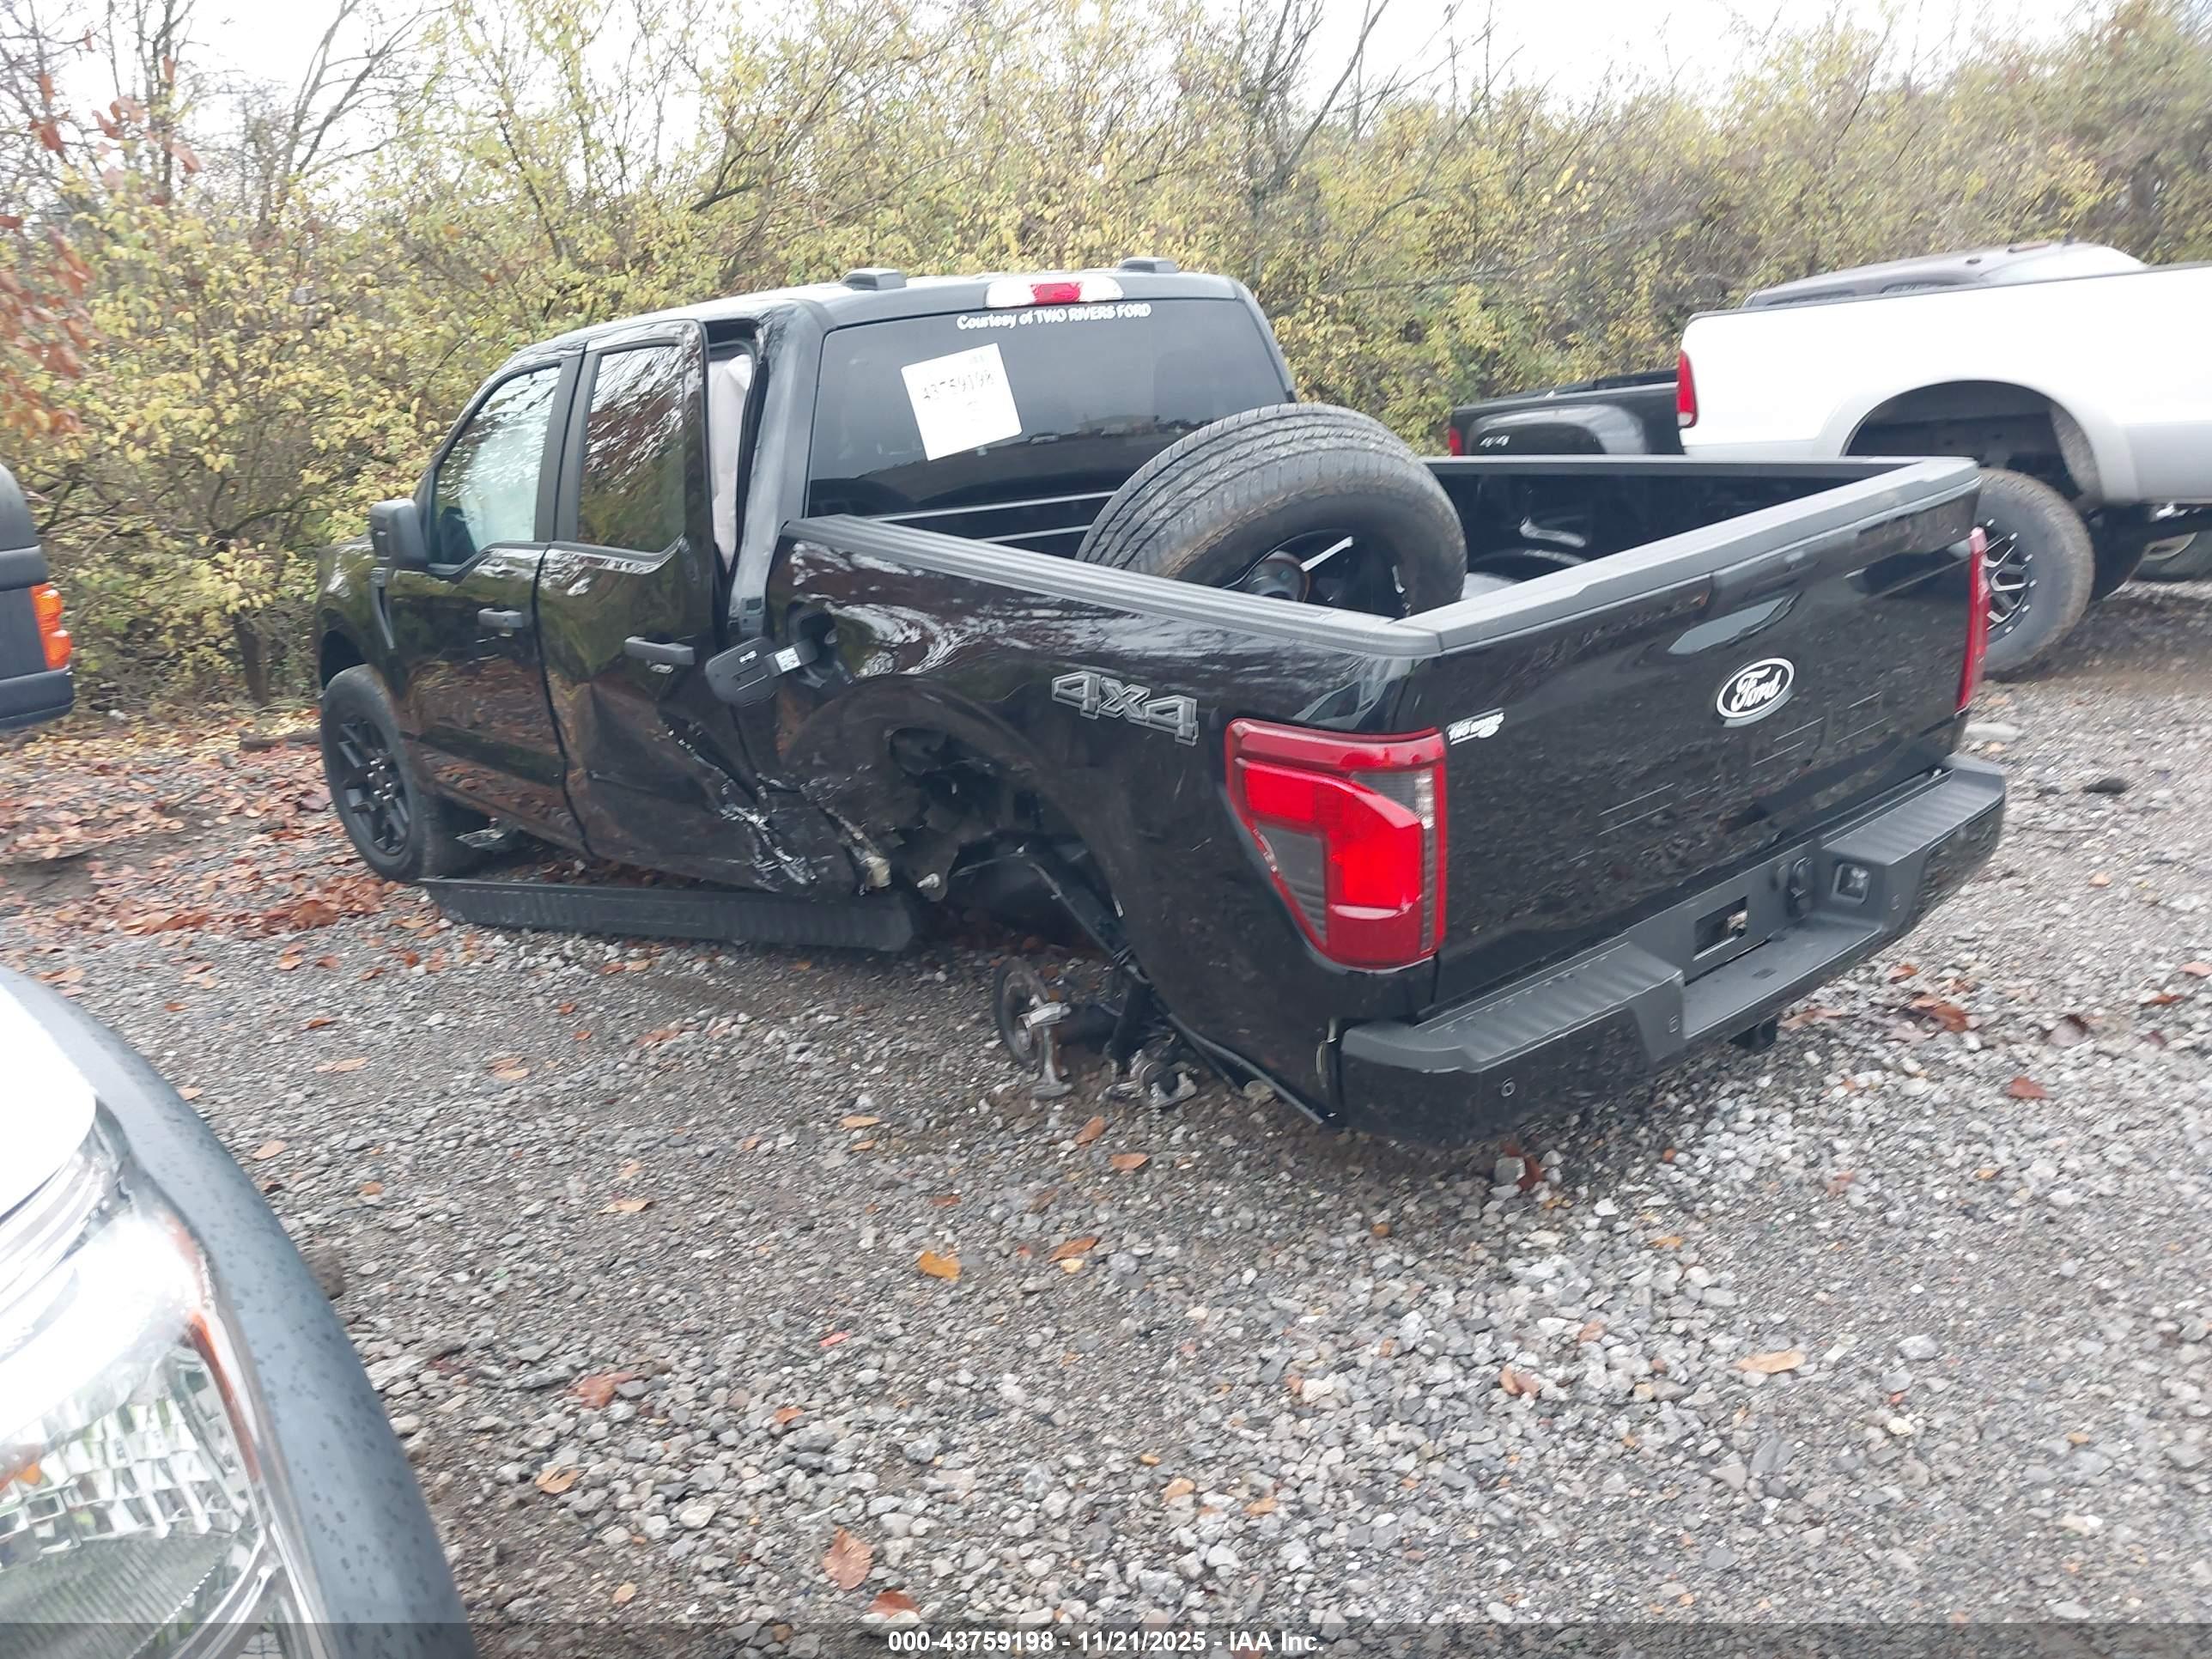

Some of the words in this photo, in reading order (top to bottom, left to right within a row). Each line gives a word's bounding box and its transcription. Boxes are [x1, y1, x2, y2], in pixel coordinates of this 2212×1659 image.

[956, 313, 1017, 330] Courtesy
[1019, 310, 1034, 325] of
[1034, 307, 1066, 324] TWO
[1068, 305, 1115, 322] RIVERS
[1115, 303, 1152, 319] FORD
[1730, 665, 1784, 713] Ford
